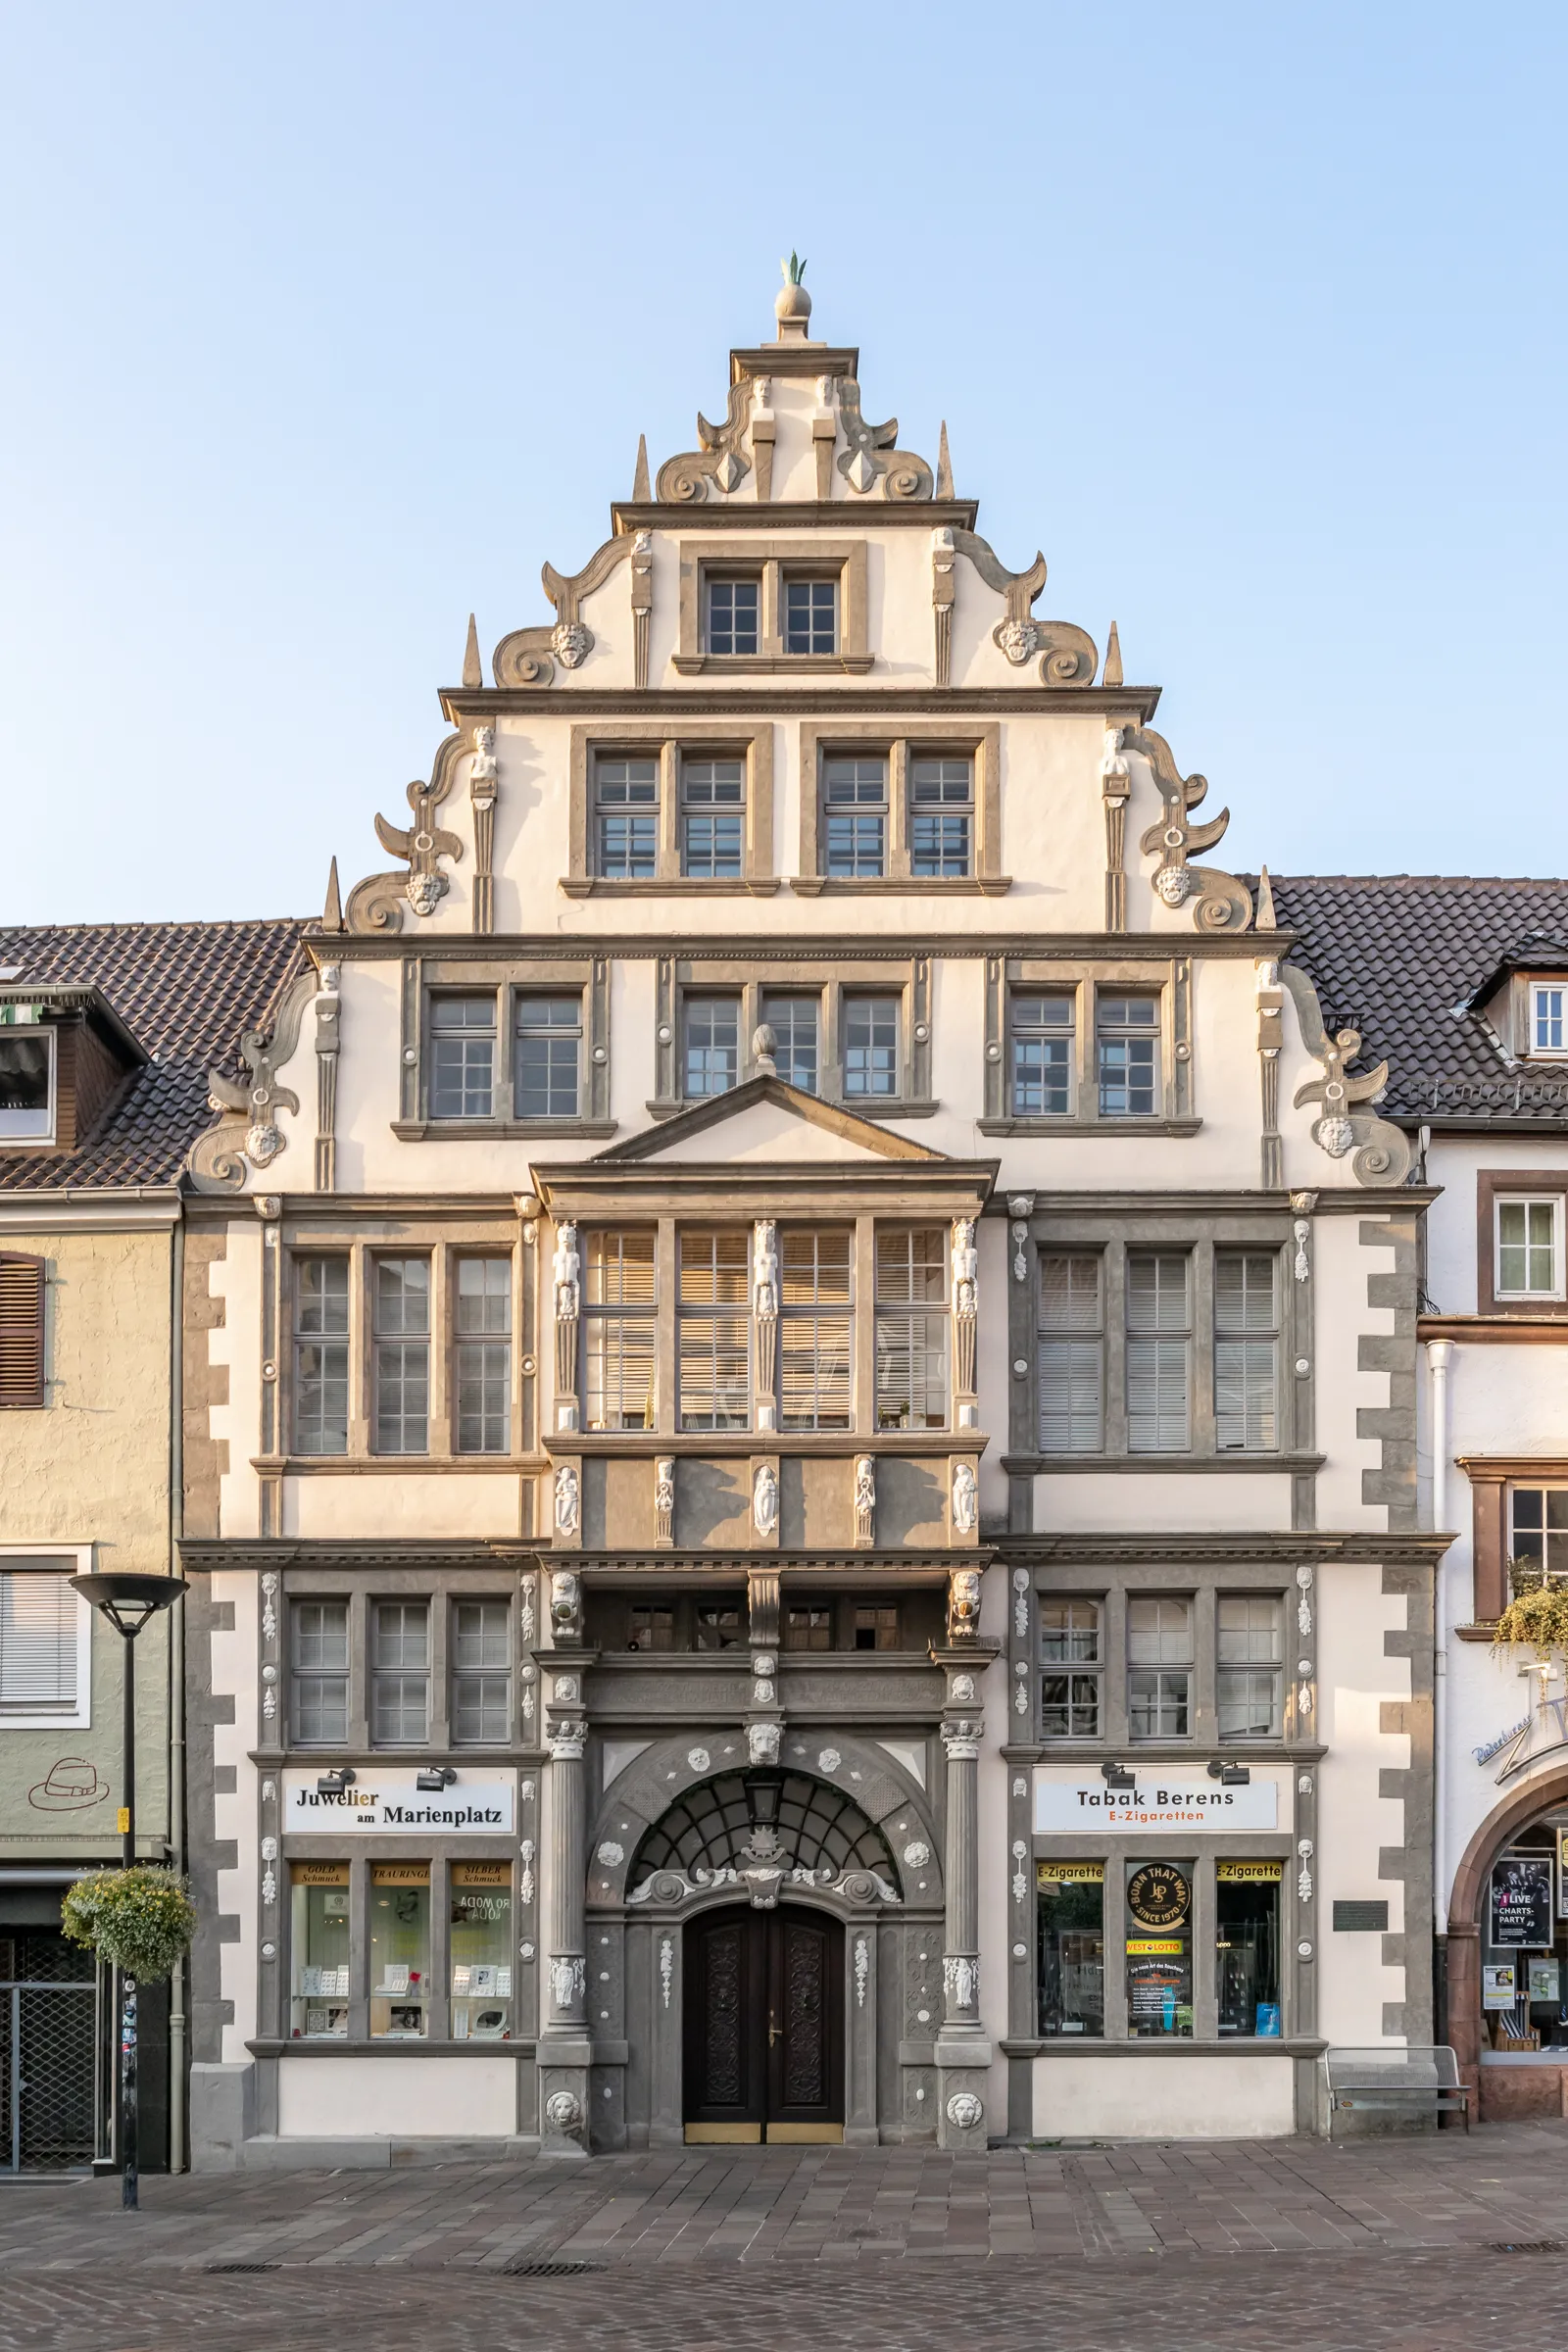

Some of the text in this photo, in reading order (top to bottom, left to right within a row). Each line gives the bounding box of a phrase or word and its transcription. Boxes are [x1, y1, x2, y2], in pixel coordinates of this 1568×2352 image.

[296, 1789, 379, 1806] Juwelier
[1077, 1790, 1234, 1806] Tabak Berens
[357, 1806, 502, 1828] am Marienplatz
[1108, 1810, 1204, 1823] E-Zigaretten
[465, 1865, 502, 1874] SILBER
[1038, 1866, 1103, 1880] E-Zigarette
[1216, 1865, 1281, 1879] E-Zigarette
[301, 1874, 341, 1883] Schmuck
[463, 1874, 503, 1883] Schmuck
[1130, 1867, 1186, 1904] BORN THAT WAY
[1137, 1906, 1180, 1923] SINCE 1970
